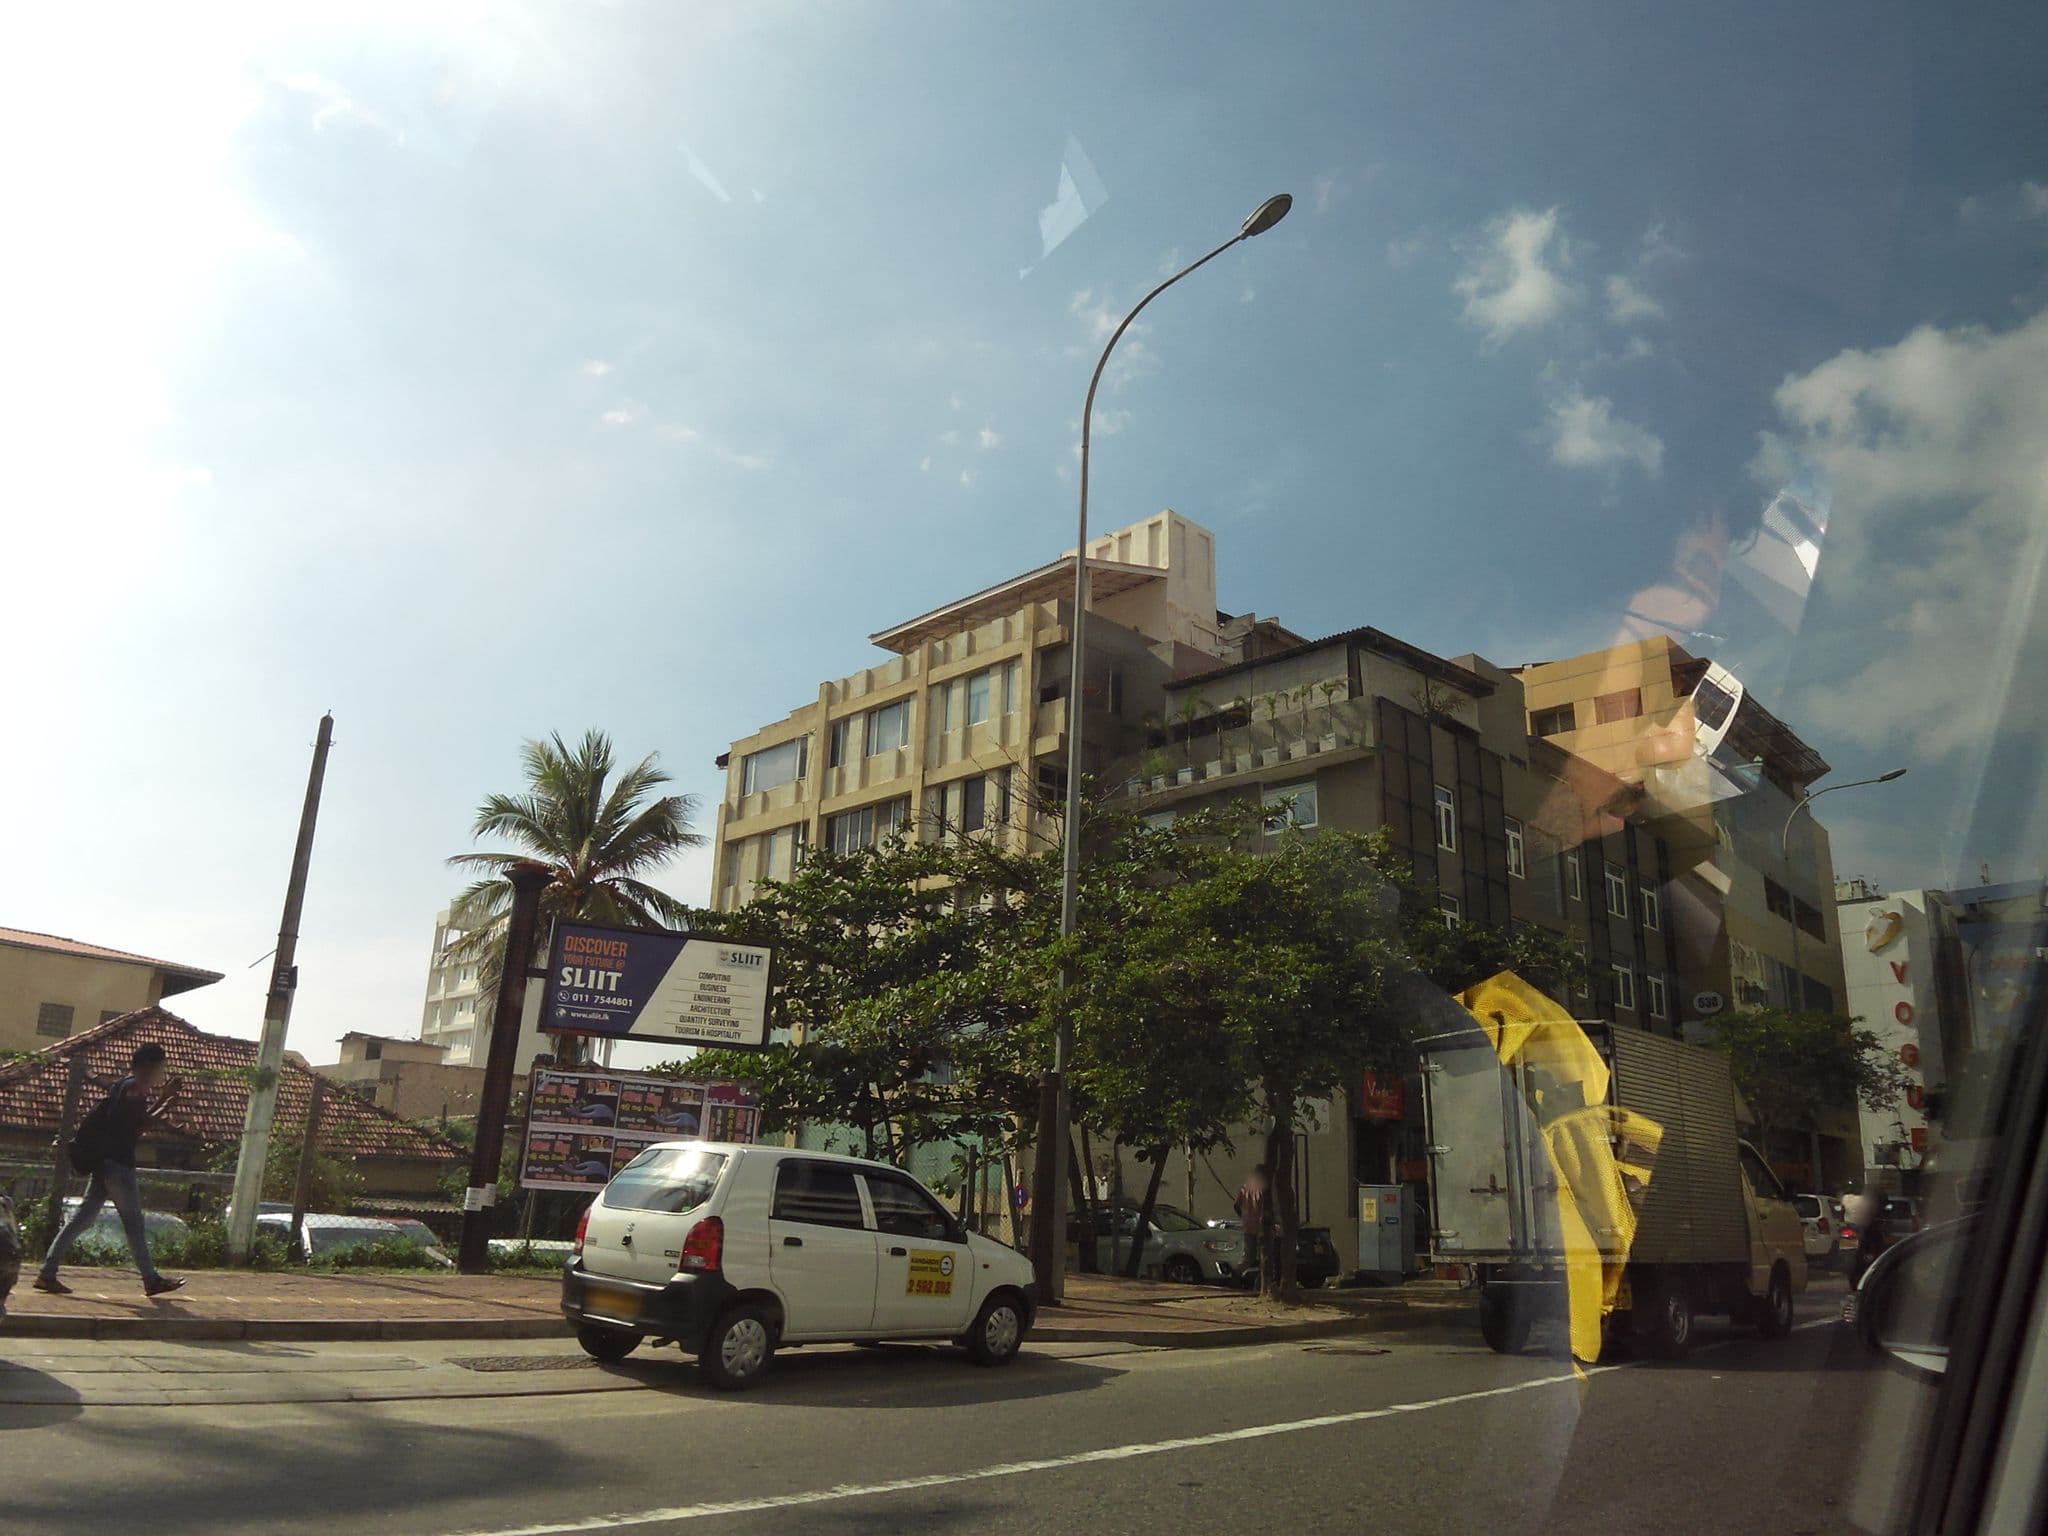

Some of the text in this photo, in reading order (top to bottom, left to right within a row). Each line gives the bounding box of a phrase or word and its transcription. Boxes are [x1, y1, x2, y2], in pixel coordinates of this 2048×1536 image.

[565, 935, 628, 958] DISCOVER
[563, 954, 583, 965] YOUR
[585, 956, 613, 969] FUTURE
[731, 952, 762, 966] SLIIT
[560, 966, 622, 991] SLIIT
[698, 971, 731, 983] COMPUTING
[699, 982, 728, 993] BUSINESS
[572, 992, 589, 1003] 011
[693, 993, 731, 1005] ENGINEERING
[690, 1004, 732, 1016] ARCHITECTURE
[679, 1014, 740, 1028] QUANTITY SURVEYING
[675, 1025, 700, 1036] TOURISM
[706, 1029, 742, 1041] HOSPITALITY
